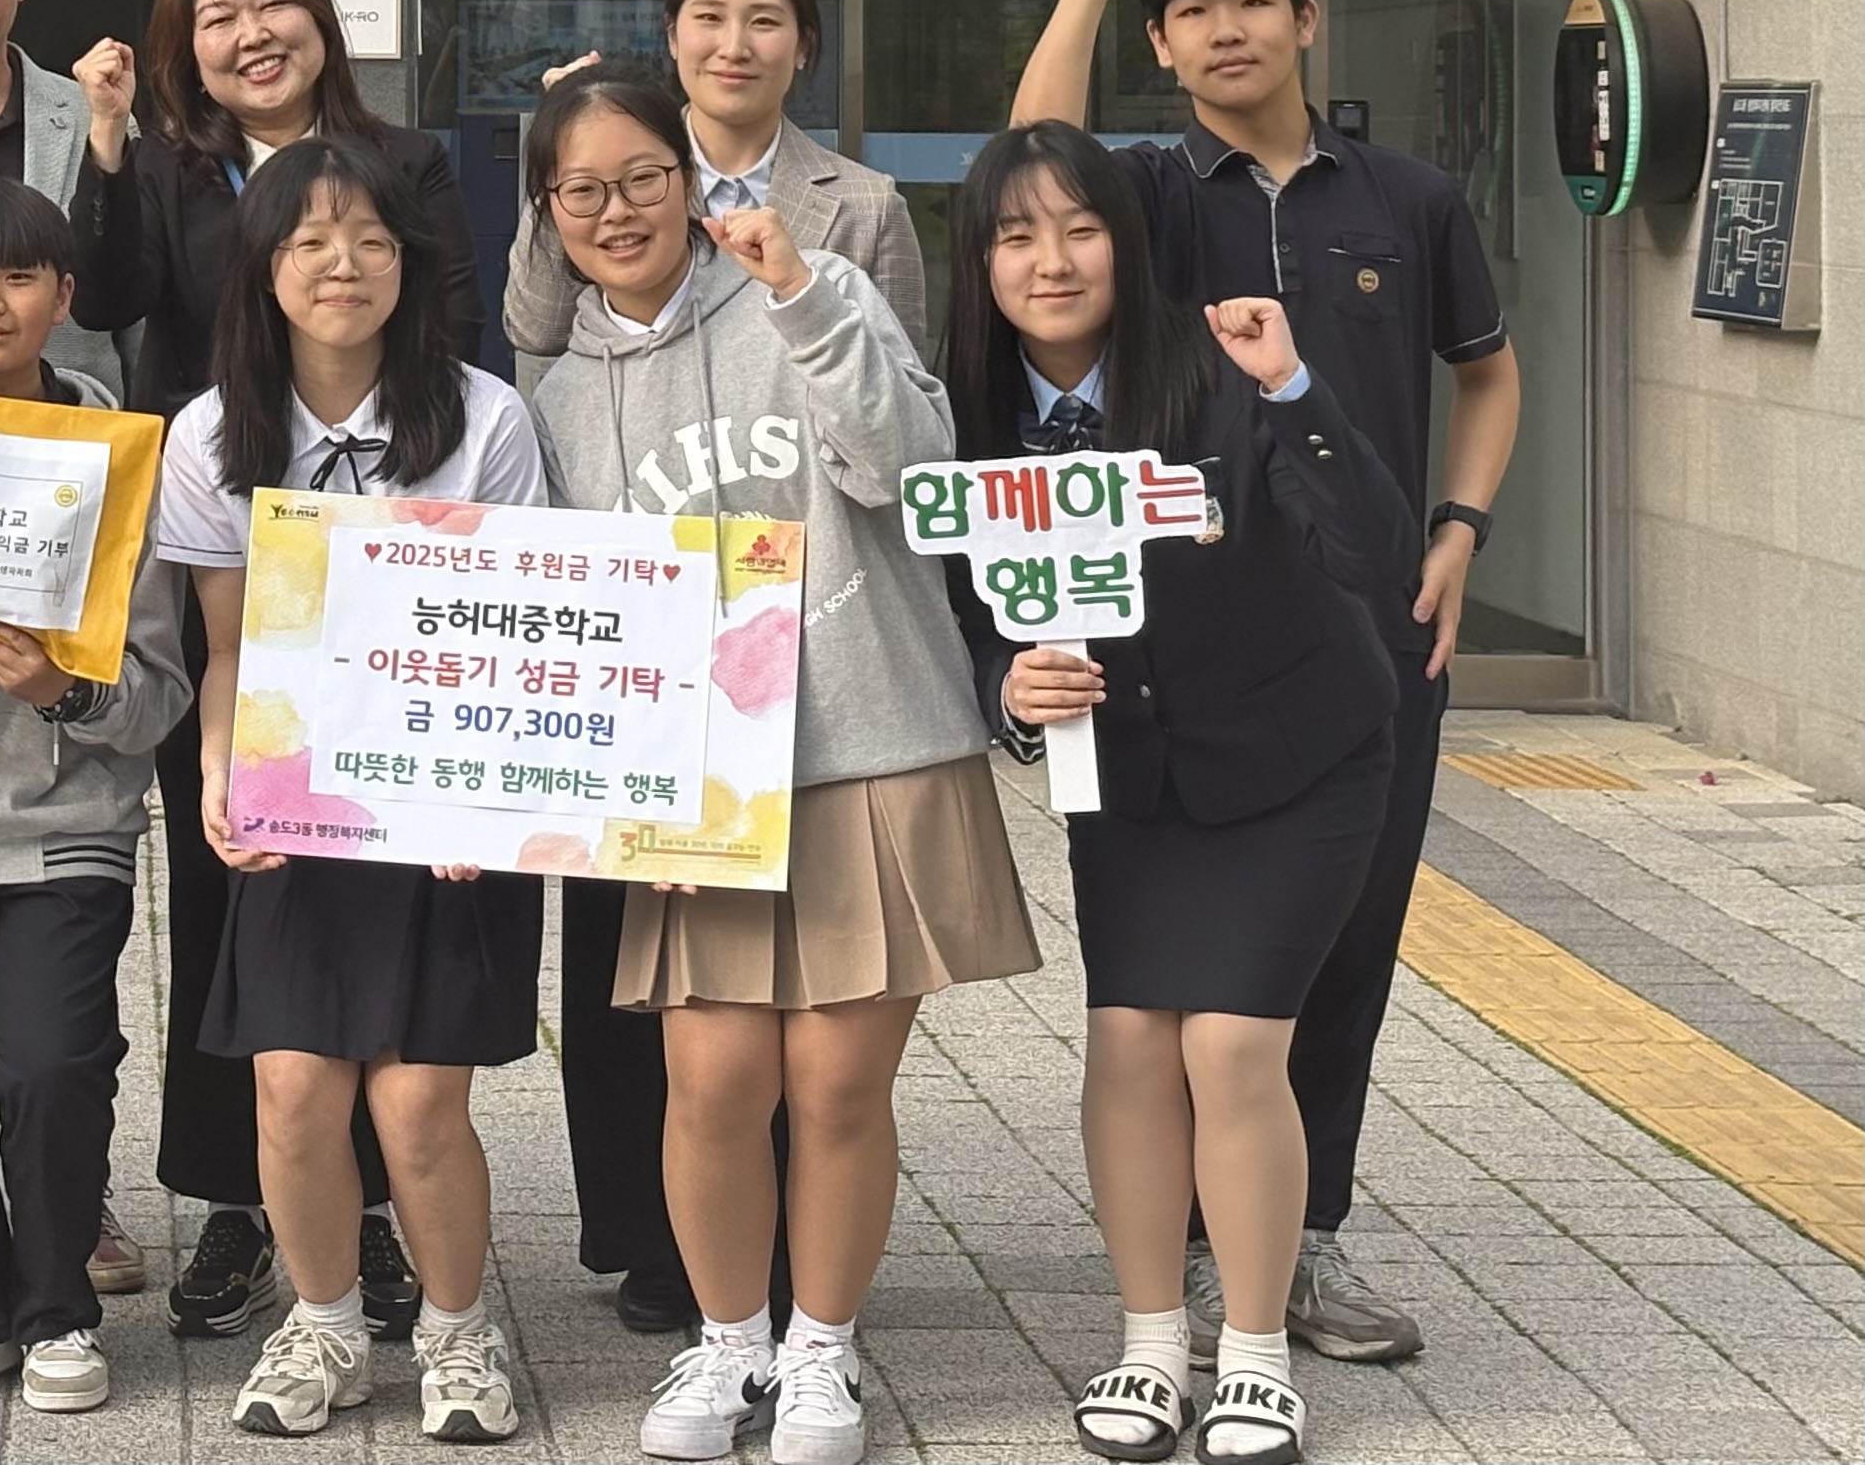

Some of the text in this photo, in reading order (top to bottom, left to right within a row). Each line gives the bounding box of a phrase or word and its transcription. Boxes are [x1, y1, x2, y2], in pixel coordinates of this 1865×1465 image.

[903, 460, 1204, 539] 함께하는
[37, 540, 69, 558] 기부
[386, 542, 659, 586] 2025년도 후원금 기탁
[823, 568, 868, 614] SCHOOL
[986, 552, 1135, 625] 행복
[412, 596, 623, 646] 능허대중학교
[367, 649, 498, 688] 이웃돕기
[515, 658, 581, 696] 성금
[599, 665, 665, 703] 기탁
[405, 699, 615, 747] 금 907,300원
[334, 751, 678, 806] 따뜻한 동행 함께하는 행복
[269, 818, 314, 837] 송도3동
[1085, 1375, 1172, 1412] NIKE
